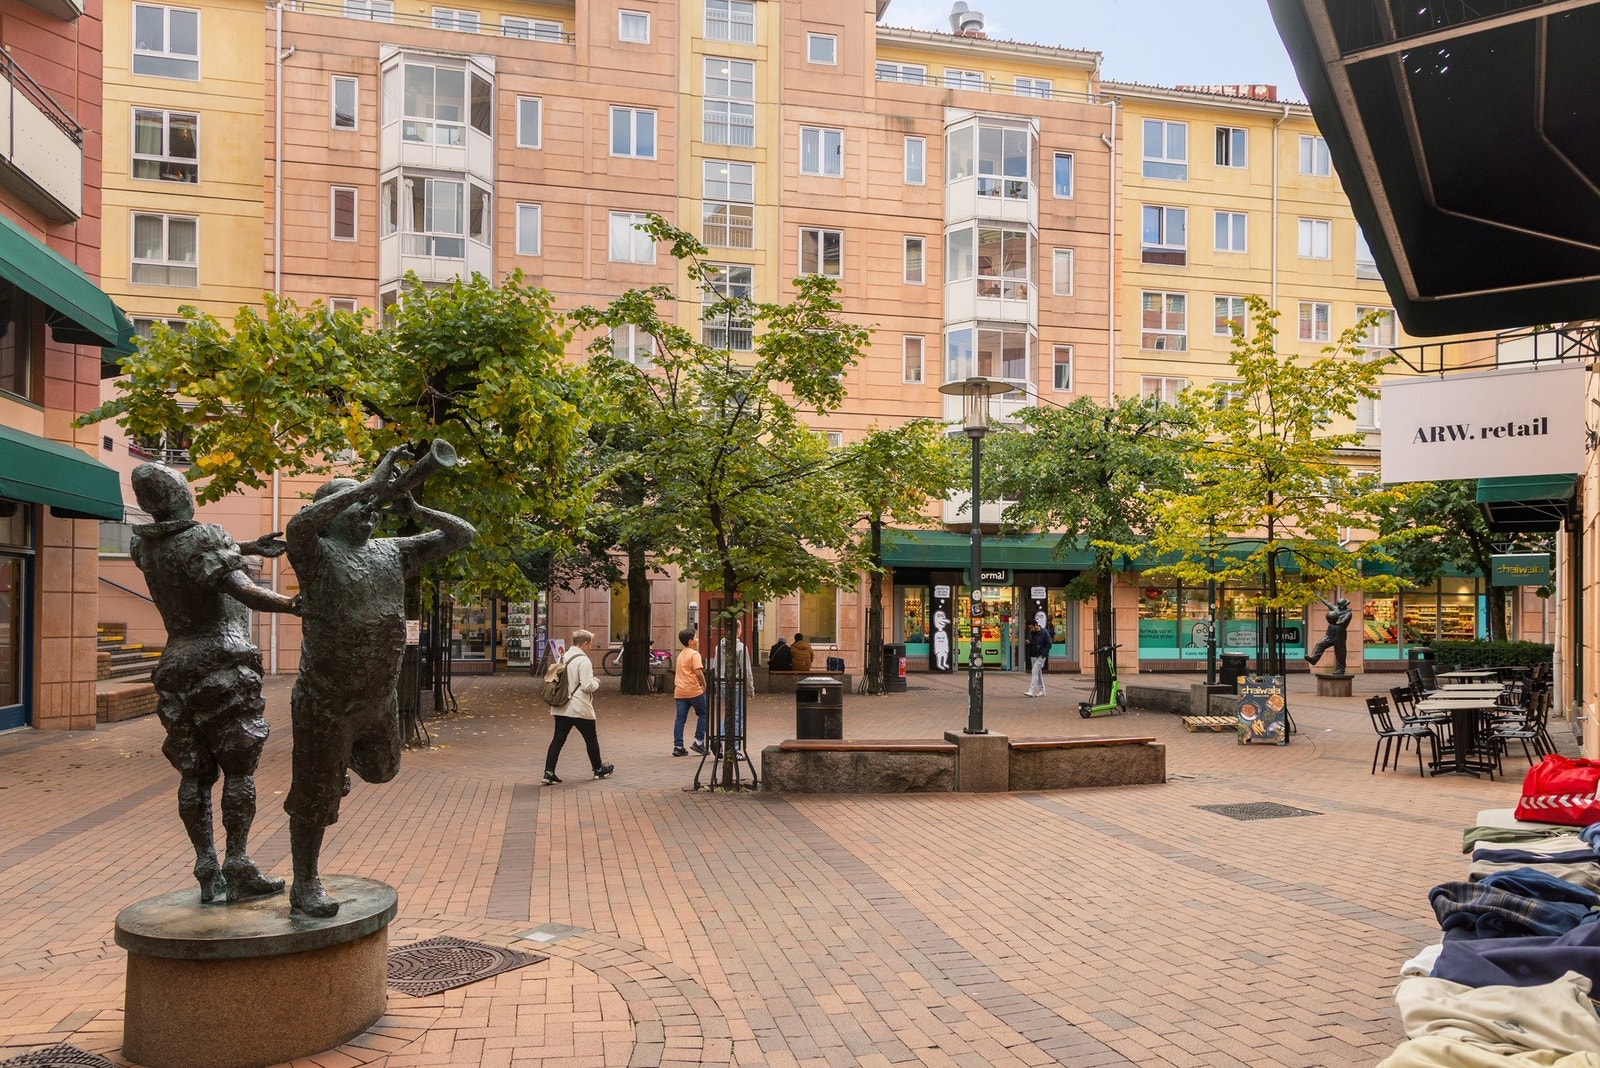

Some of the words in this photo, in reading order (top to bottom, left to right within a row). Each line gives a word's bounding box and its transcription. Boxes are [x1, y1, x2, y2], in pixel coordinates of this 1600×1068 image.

[1412, 423, 1475, 445] ARW.
[1481, 417, 1548, 439] retail
[980, 570, 1005, 579] ormal
